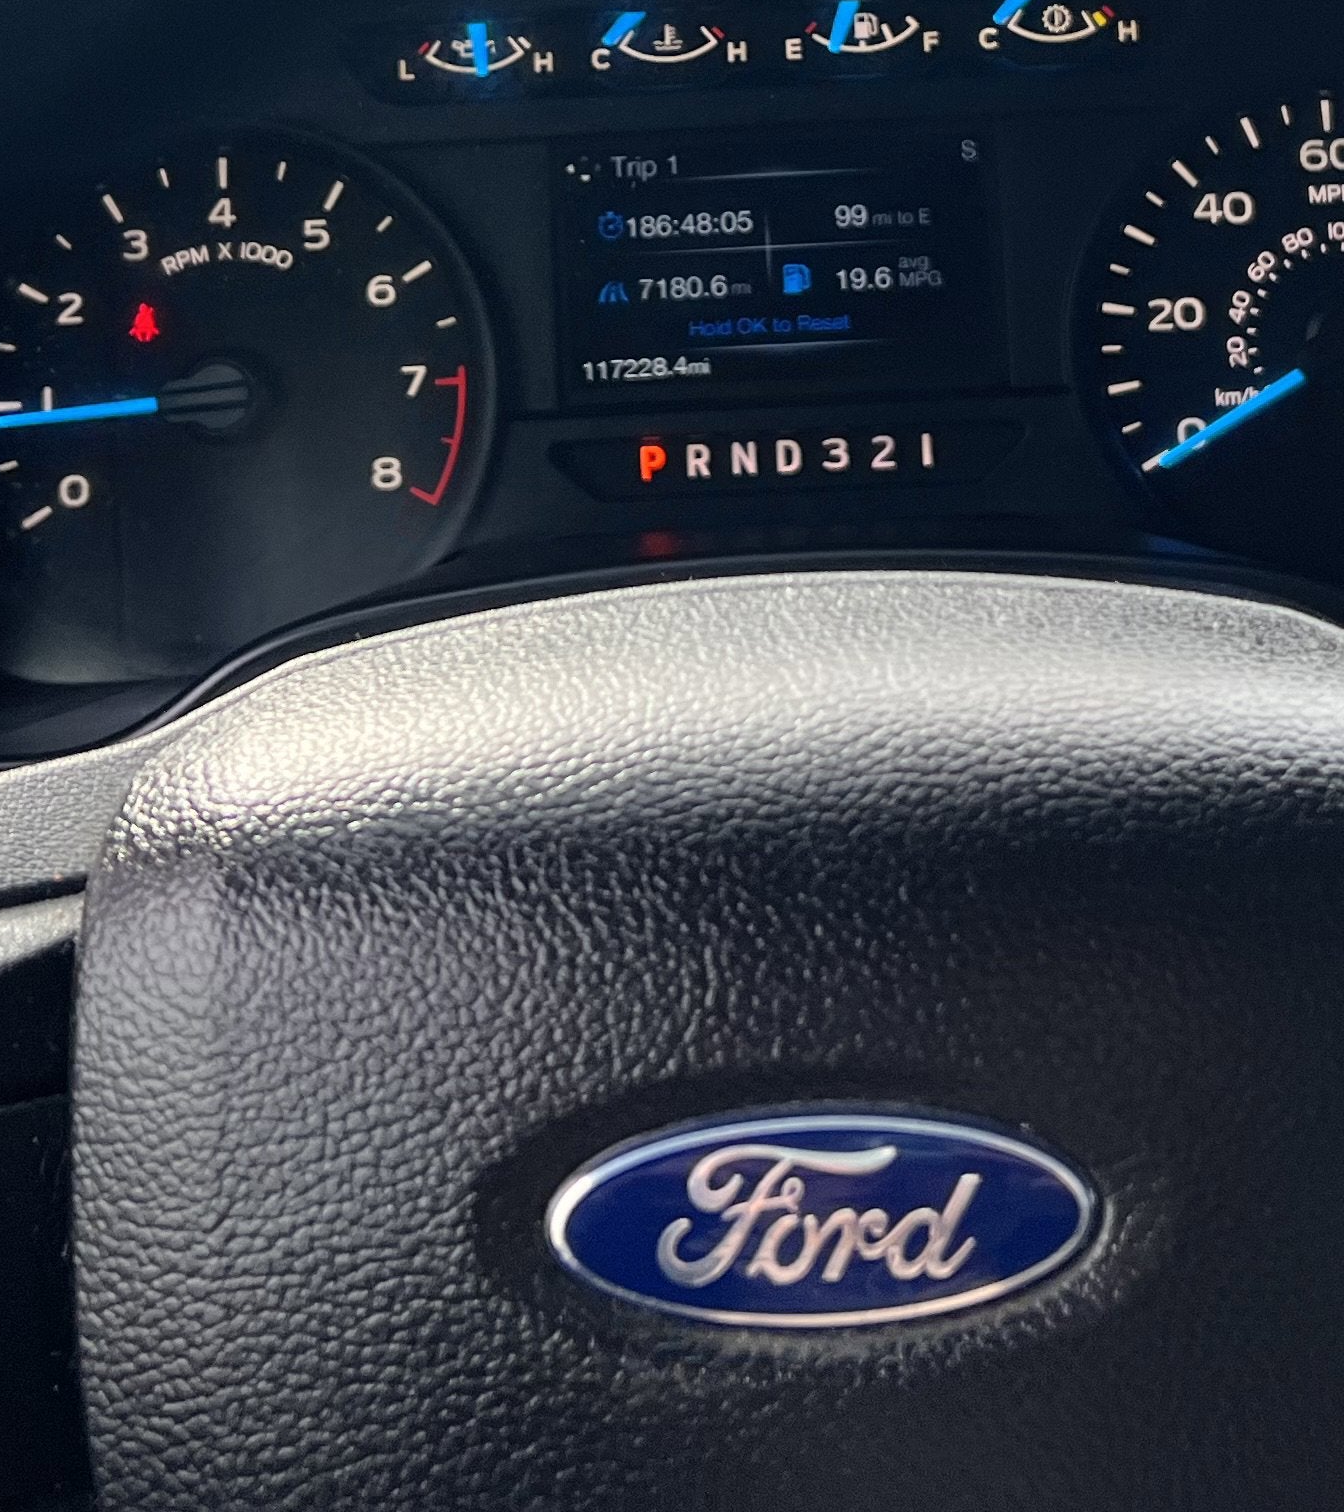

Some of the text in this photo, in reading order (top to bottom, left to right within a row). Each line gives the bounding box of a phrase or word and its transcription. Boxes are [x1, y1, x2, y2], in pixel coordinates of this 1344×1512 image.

[918, 24, 939, 53] F
[978, 27, 999, 50] C
[1117, 19, 1138, 43] H
[534, 52, 554, 73] H
[591, 47, 611, 70] C
[726, 40, 747, 63] H
[785, 37, 803, 60] E
[398, 59, 416, 81] L
[961, 139, 977, 162] S
[610, 155, 678, 182] Trip 1
[207, 197, 237, 228] 4
[834, 203, 869, 228] 99
[897, 210, 915, 225] to
[918, 207, 931, 225] E
[1194, 191, 1253, 224] 40
[303, 218, 331, 251] 5
[626, 209, 754, 238] 186:48:05
[123, 229, 149, 261] 3
[1281, 227, 1314, 256] 80
[160, 241, 294, 276] RPM X 1000
[1248, 251, 1276, 281] 60
[366, 274, 396, 306] 6
[638, 274, 728, 300] 7180.6
[835, 266, 943, 291] 19.6 MPG
[57, 292, 84, 325] 2
[1147, 296, 1205, 331] 20
[1229, 291, 1251, 325] 40
[737, 317, 767, 335] OK
[773, 318, 791, 333] to
[1227, 336, 1248, 367] 20
[400, 364, 427, 397] 7
[583, 356, 711, 381] 117228.4mi
[639, 445, 666, 482] P
[686, 443, 711, 477] R
[731, 441, 758, 475] N
[775, 439, 802, 474] D
[822, 437, 850, 471] 3
[871, 435, 896, 470] 2
[371, 456, 403, 491] 8
[58, 474, 90, 508] 0
[657, 1144, 982, 1287] Ford
